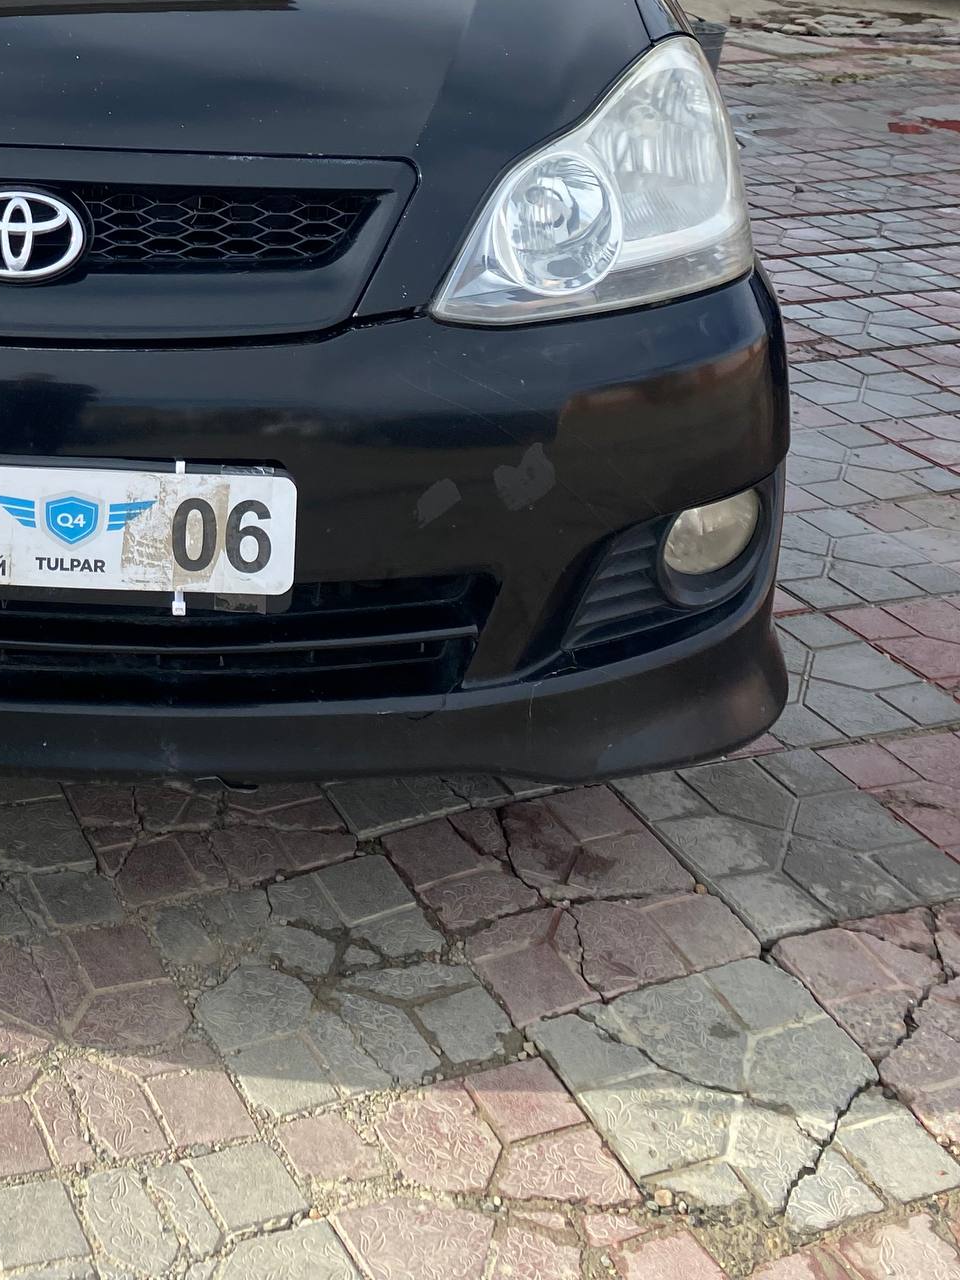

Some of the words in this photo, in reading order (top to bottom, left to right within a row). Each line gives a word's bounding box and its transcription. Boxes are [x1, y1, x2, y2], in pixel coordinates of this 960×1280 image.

[57, 512, 87, 529] Q4
[171, 497, 272, 574] 06
[35, 556, 106, 573] TULPAR
